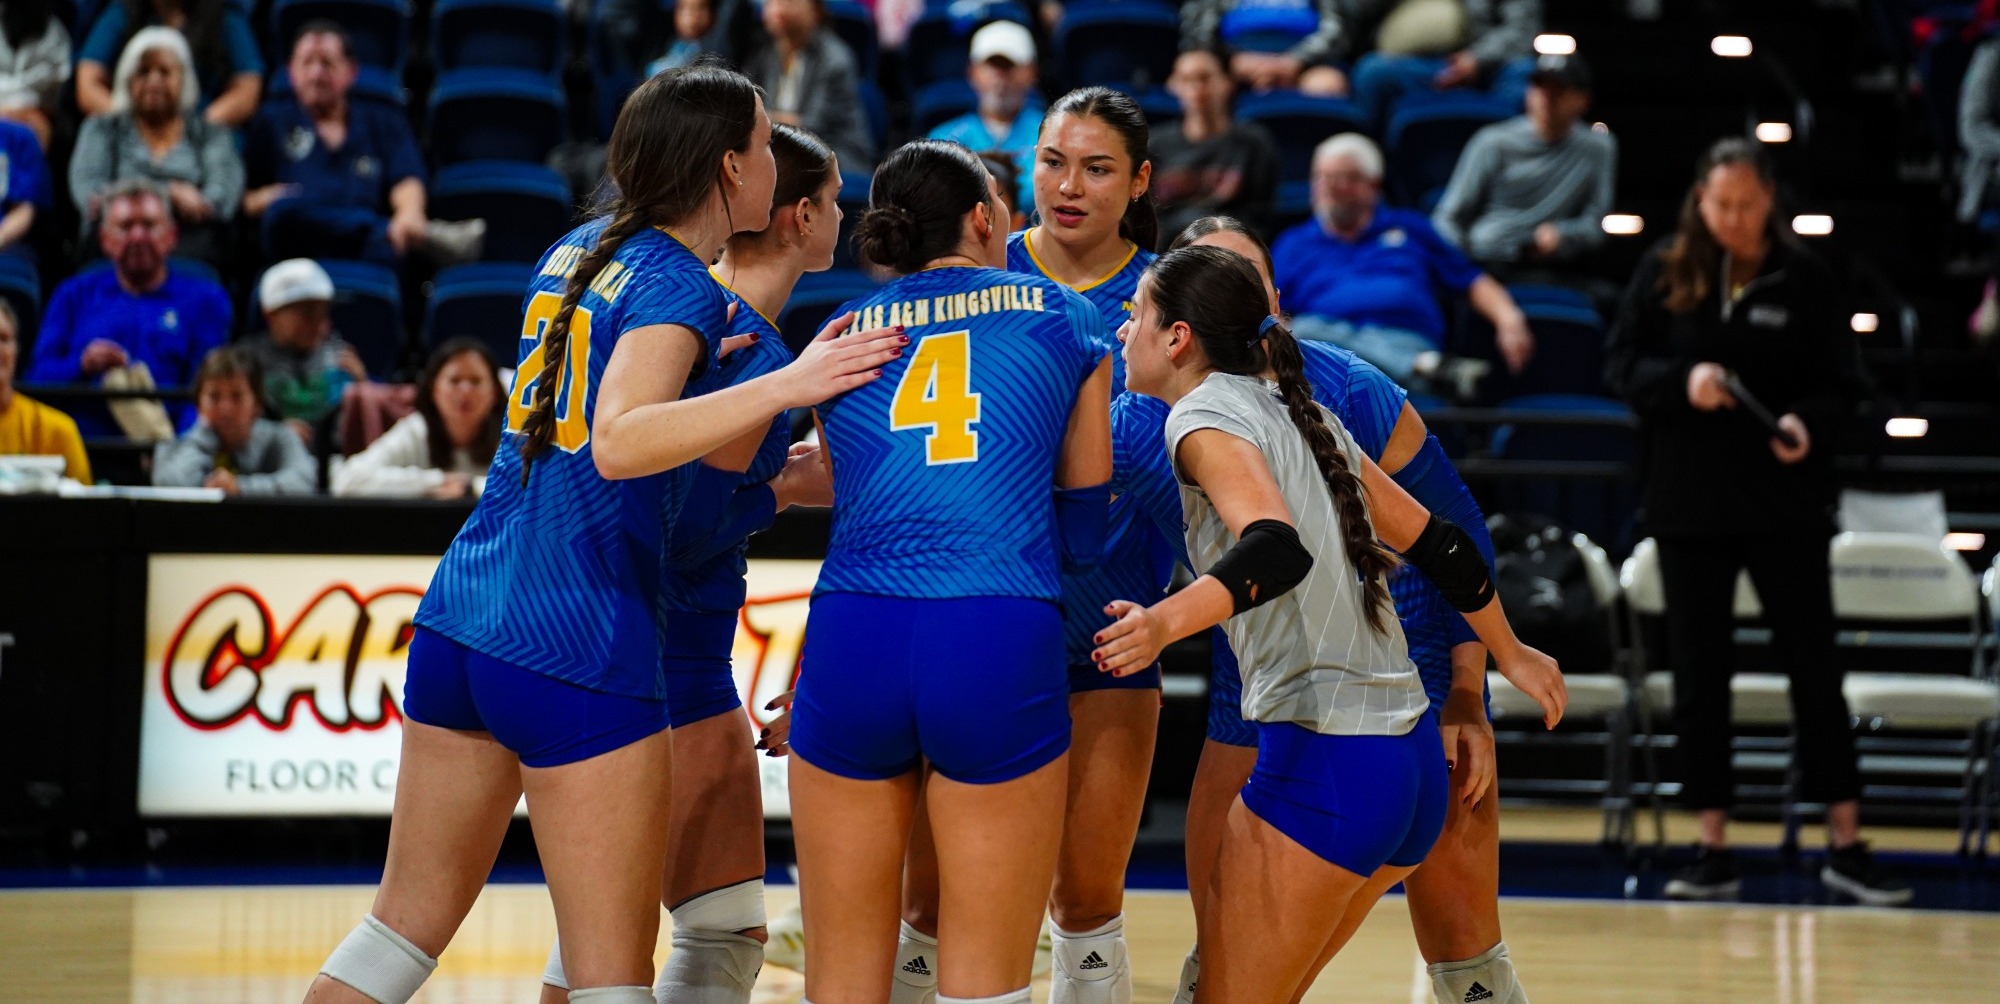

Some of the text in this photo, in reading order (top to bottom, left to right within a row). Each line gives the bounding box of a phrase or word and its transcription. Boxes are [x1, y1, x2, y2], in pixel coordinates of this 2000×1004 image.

[889, 299, 929, 328] A&M
[934, 285, 1045, 323] KINGSVILLE
[504, 290, 592, 454] 20
[890, 329, 981, 466] 4
[226, 758, 358, 793] FLOOR
[902, 964, 931, 976] adidas
[1079, 961, 1108, 970] adidas
[1464, 990, 1493, 1003] adidas
